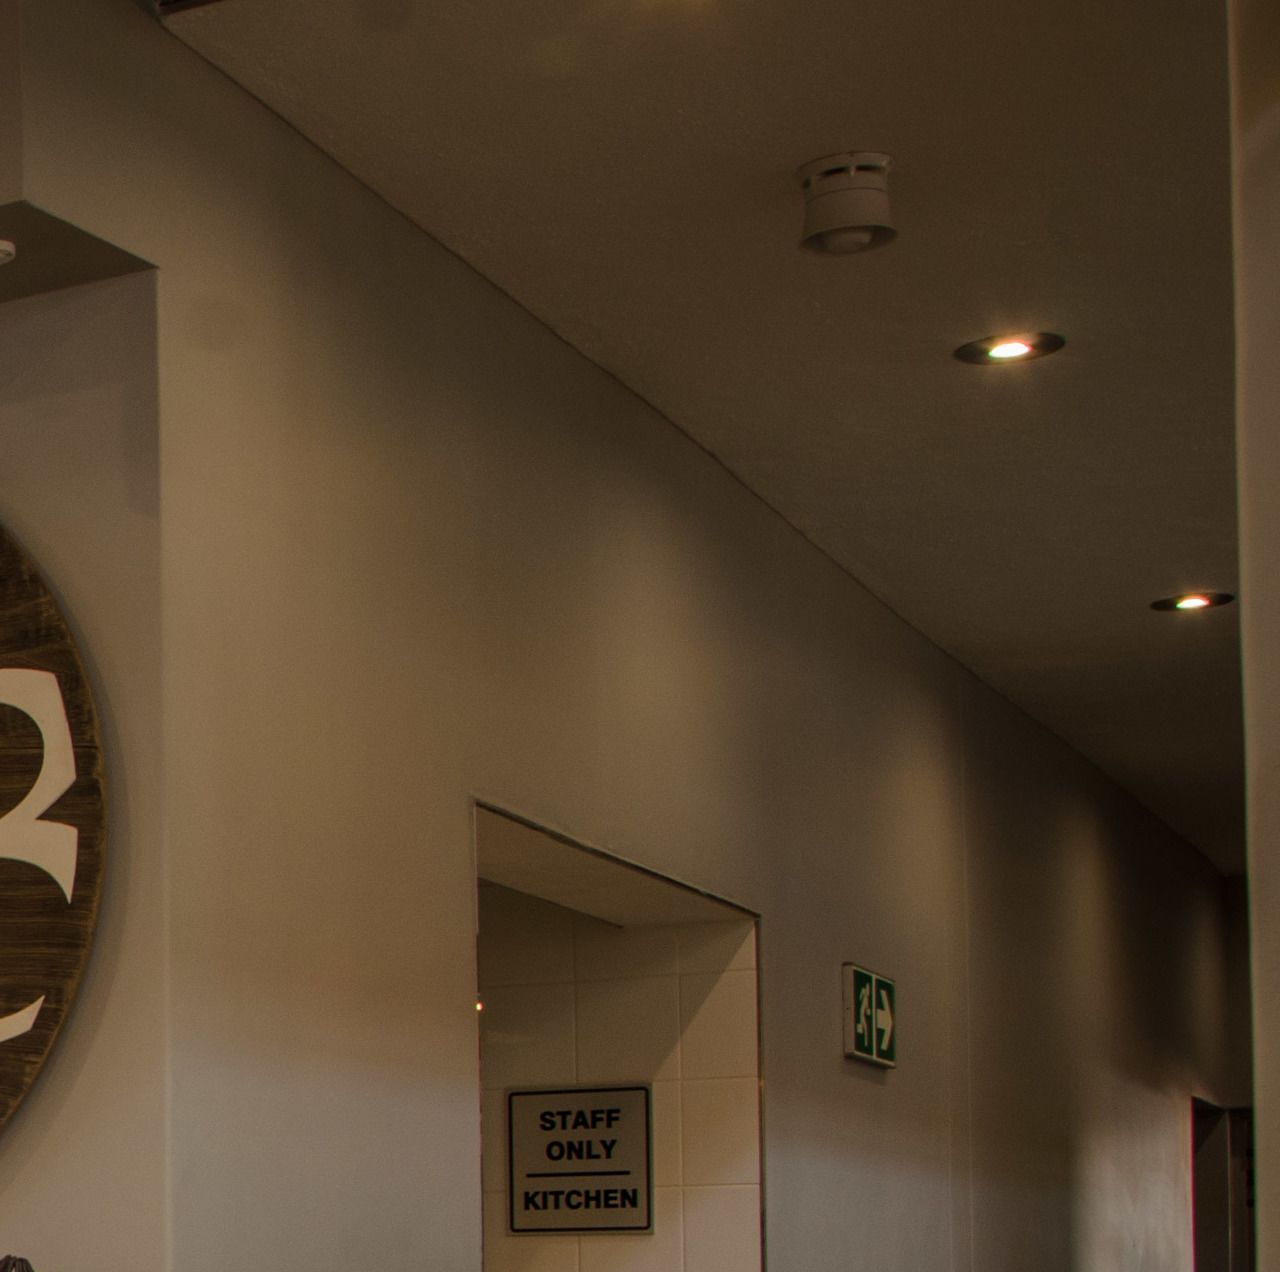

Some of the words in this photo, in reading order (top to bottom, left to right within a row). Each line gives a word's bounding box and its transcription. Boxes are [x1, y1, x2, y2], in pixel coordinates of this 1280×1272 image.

[540, 1109, 621, 1131] STAFF
[546, 1139, 618, 1161] ONLY
[523, 1188, 638, 1211] KITCHEN
